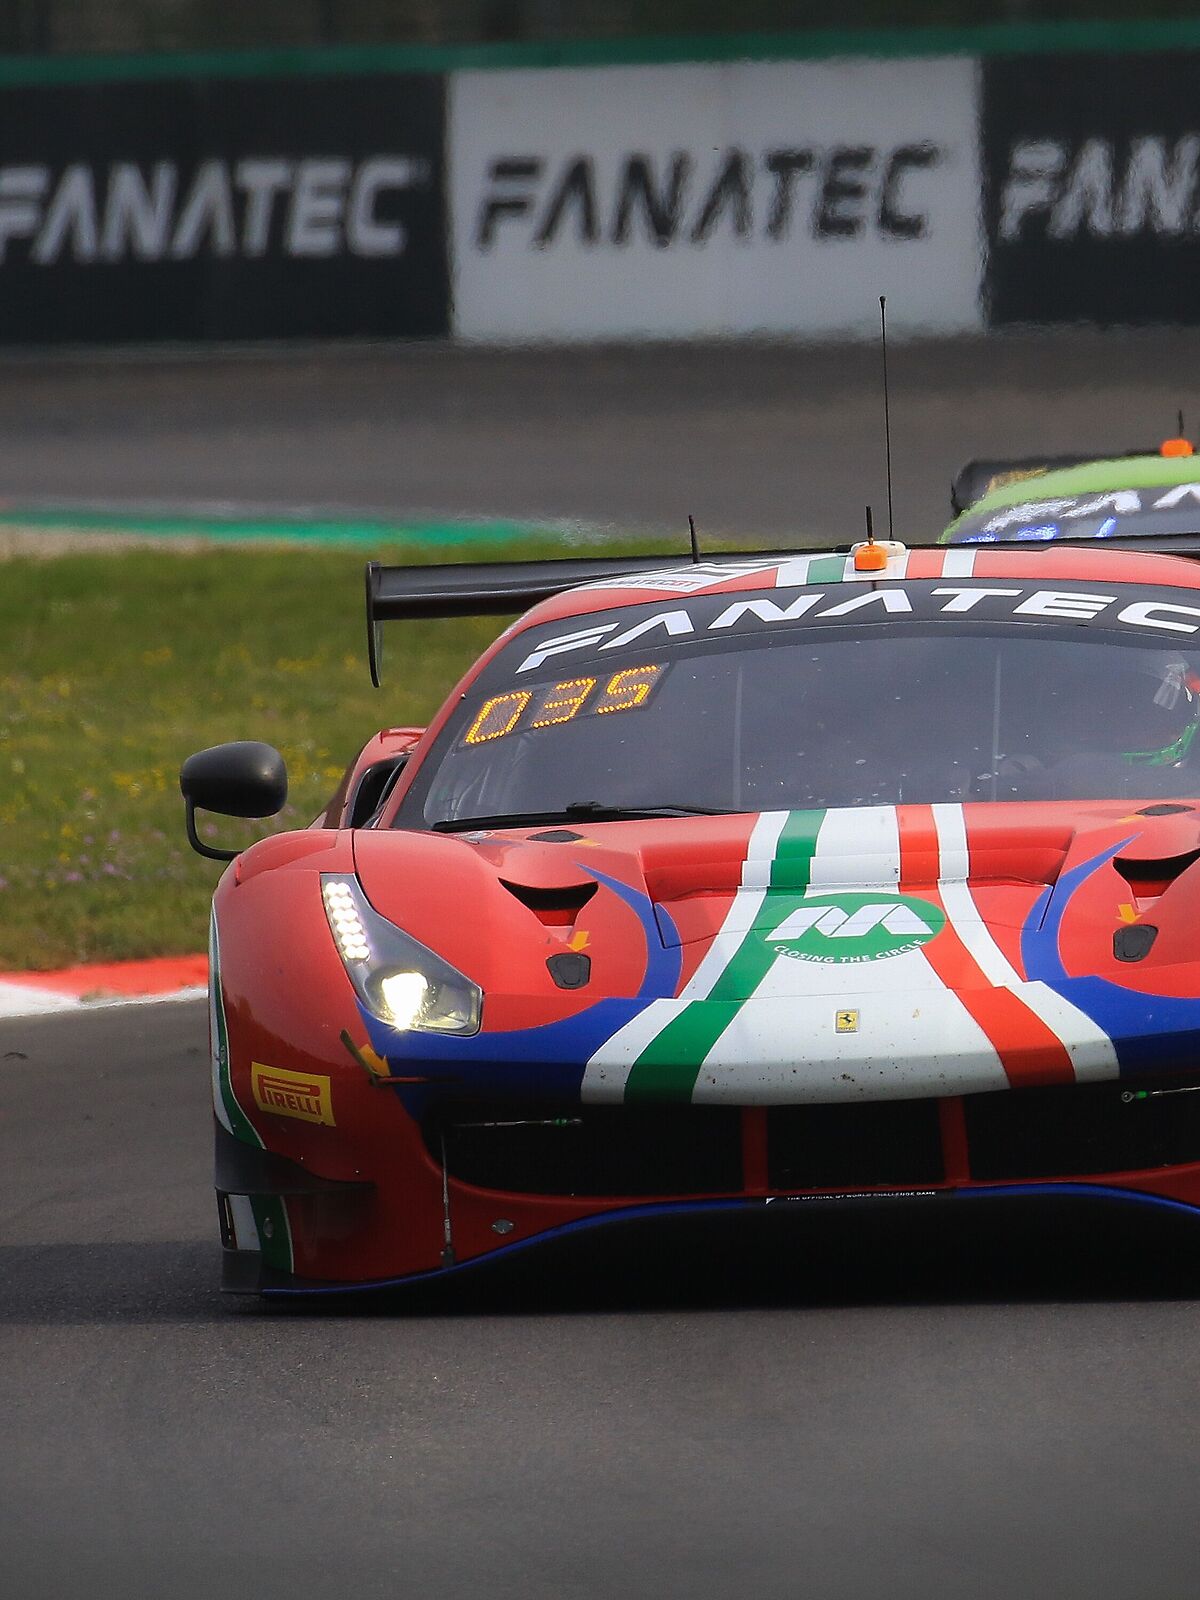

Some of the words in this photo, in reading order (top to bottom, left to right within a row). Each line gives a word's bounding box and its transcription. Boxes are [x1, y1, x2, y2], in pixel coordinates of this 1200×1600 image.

[0, 155, 411, 264] FANATEC
[475, 142, 940, 253] FANATEC
[465, 663, 662, 744] 035
[773, 945, 834, 963] CLOSING
[839, 954, 871, 963] THE
[875, 939, 926, 960] CIRCLE
[259, 1075, 321, 1115] PIRELLI
